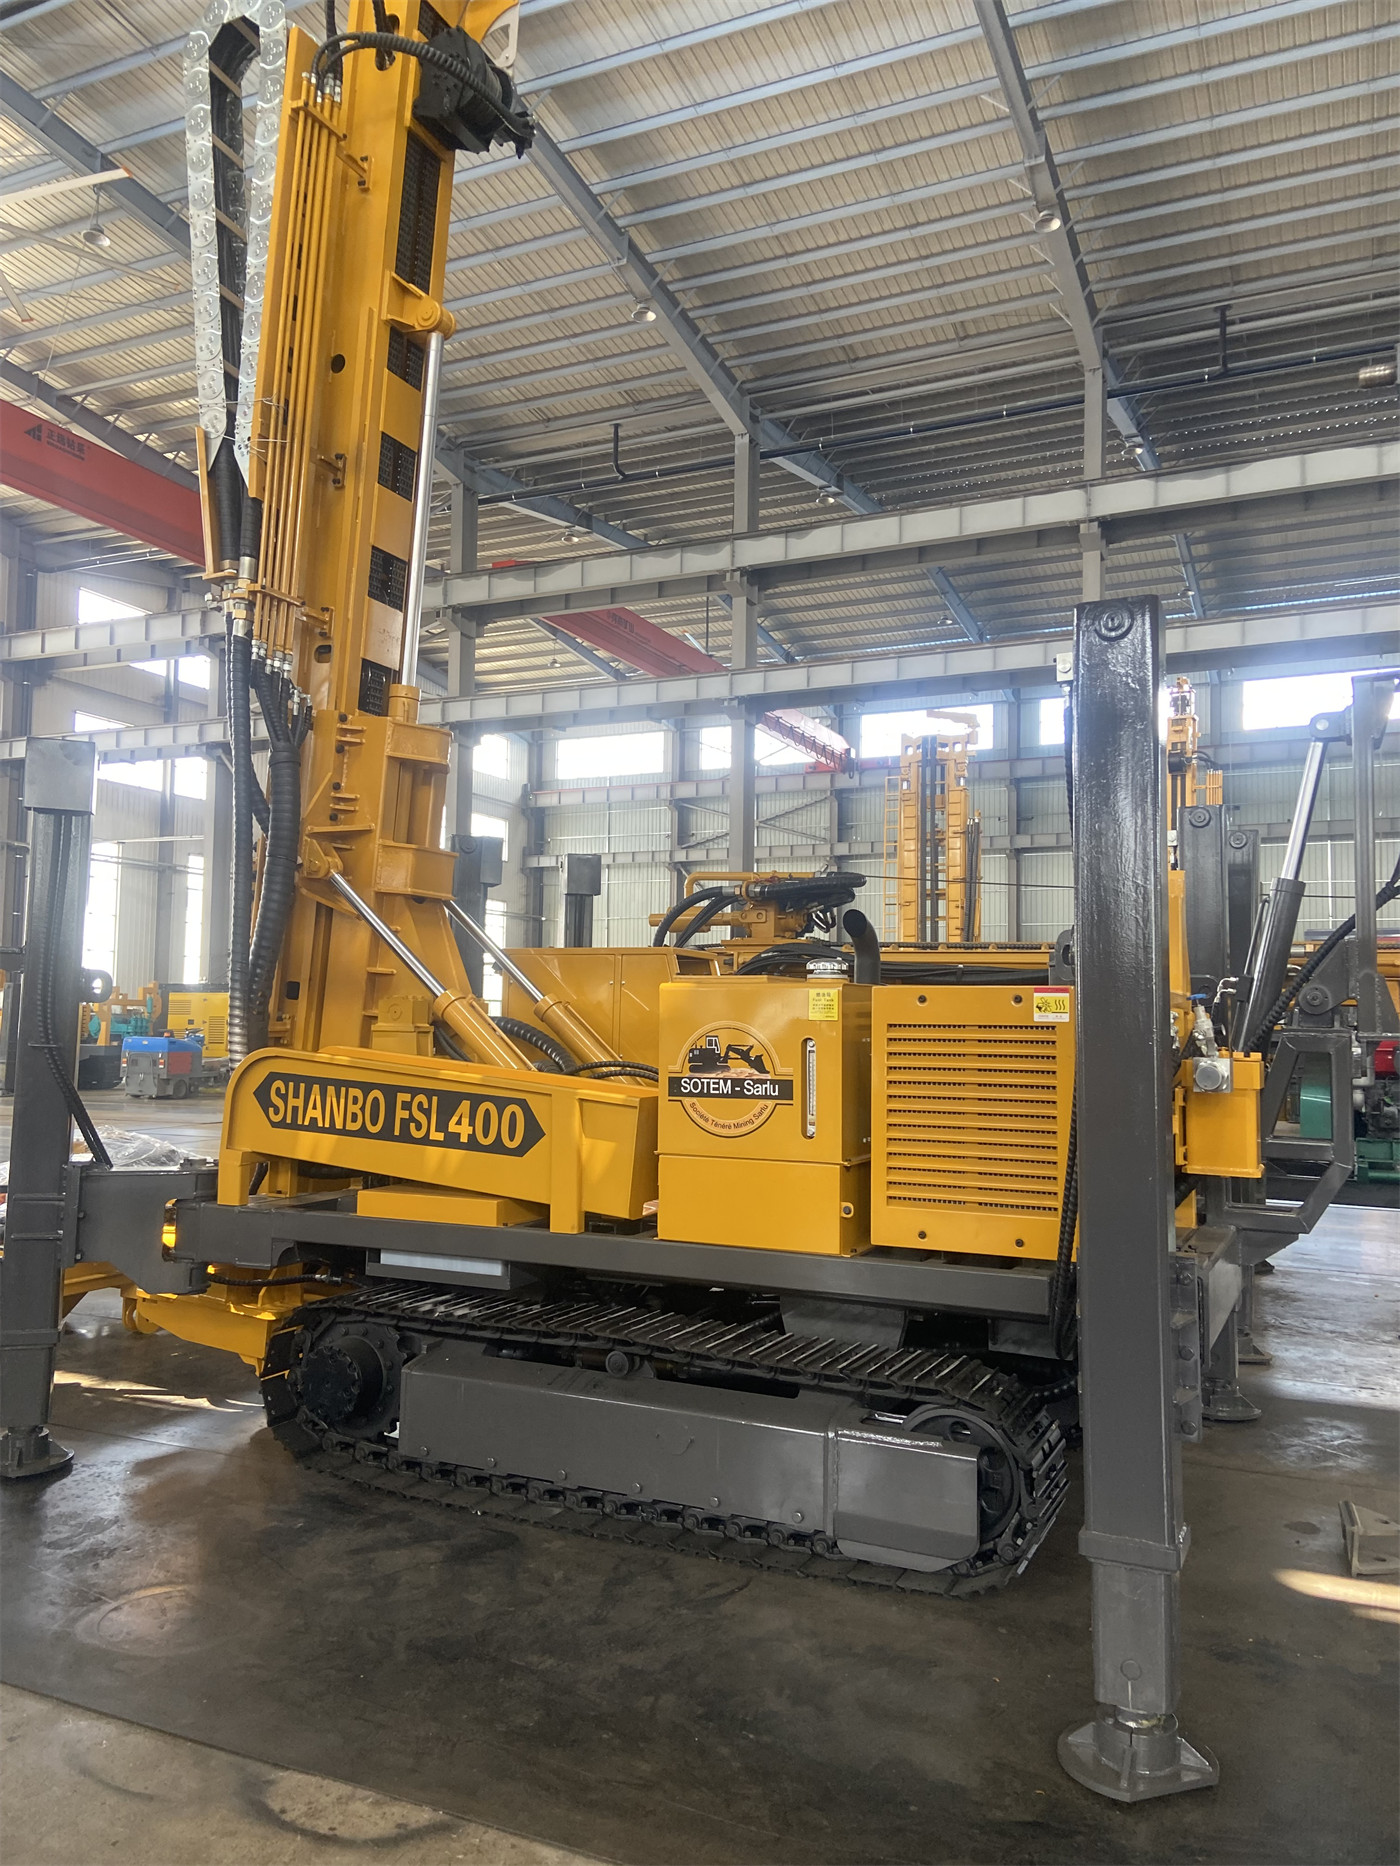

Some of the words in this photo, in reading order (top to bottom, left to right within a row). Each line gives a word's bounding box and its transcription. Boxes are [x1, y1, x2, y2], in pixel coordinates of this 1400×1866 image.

[681, 1078, 731, 1094] SOTEM
[744, 1080, 779, 1096] Sarlu
[268, 1079, 386, 1134] SHANBO
[394, 1092, 525, 1149] FSL400
[733, 1117, 755, 1129] Mining
